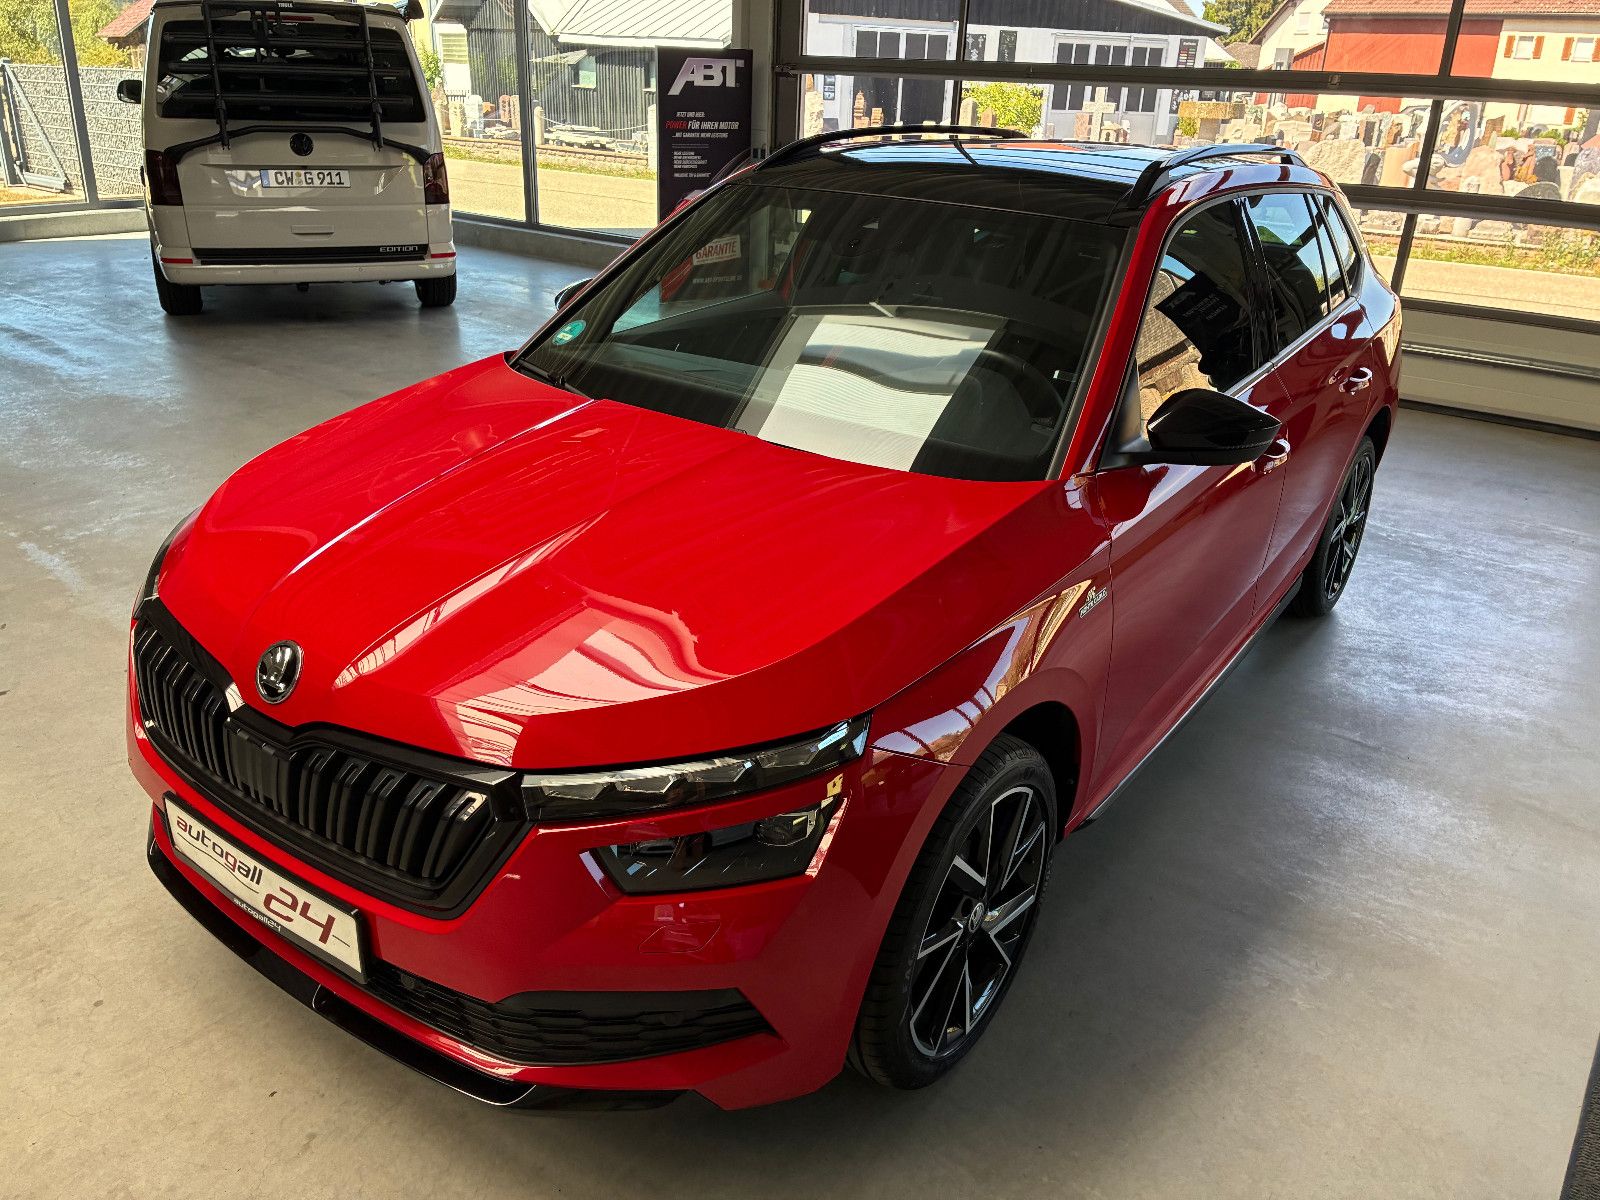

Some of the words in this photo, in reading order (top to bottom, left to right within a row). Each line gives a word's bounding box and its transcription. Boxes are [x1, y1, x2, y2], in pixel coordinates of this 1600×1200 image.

[667, 57, 745, 96] ABT
[665, 120, 688, 129] POWER
[687, 119, 700, 130] FÜR
[700, 121, 719, 130] IHREN
[719, 121, 740, 130] MOTOR
[274, 171, 294, 186] CW
[303, 171, 315, 186] G
[316, 171, 345, 186] 911
[379, 245, 418, 253] EDITION
[695, 240, 737, 260] GARANTIE
[176, 815, 263, 887] autogall
[263, 886, 336, 945] 24
[233, 897, 281, 932] autogall24
